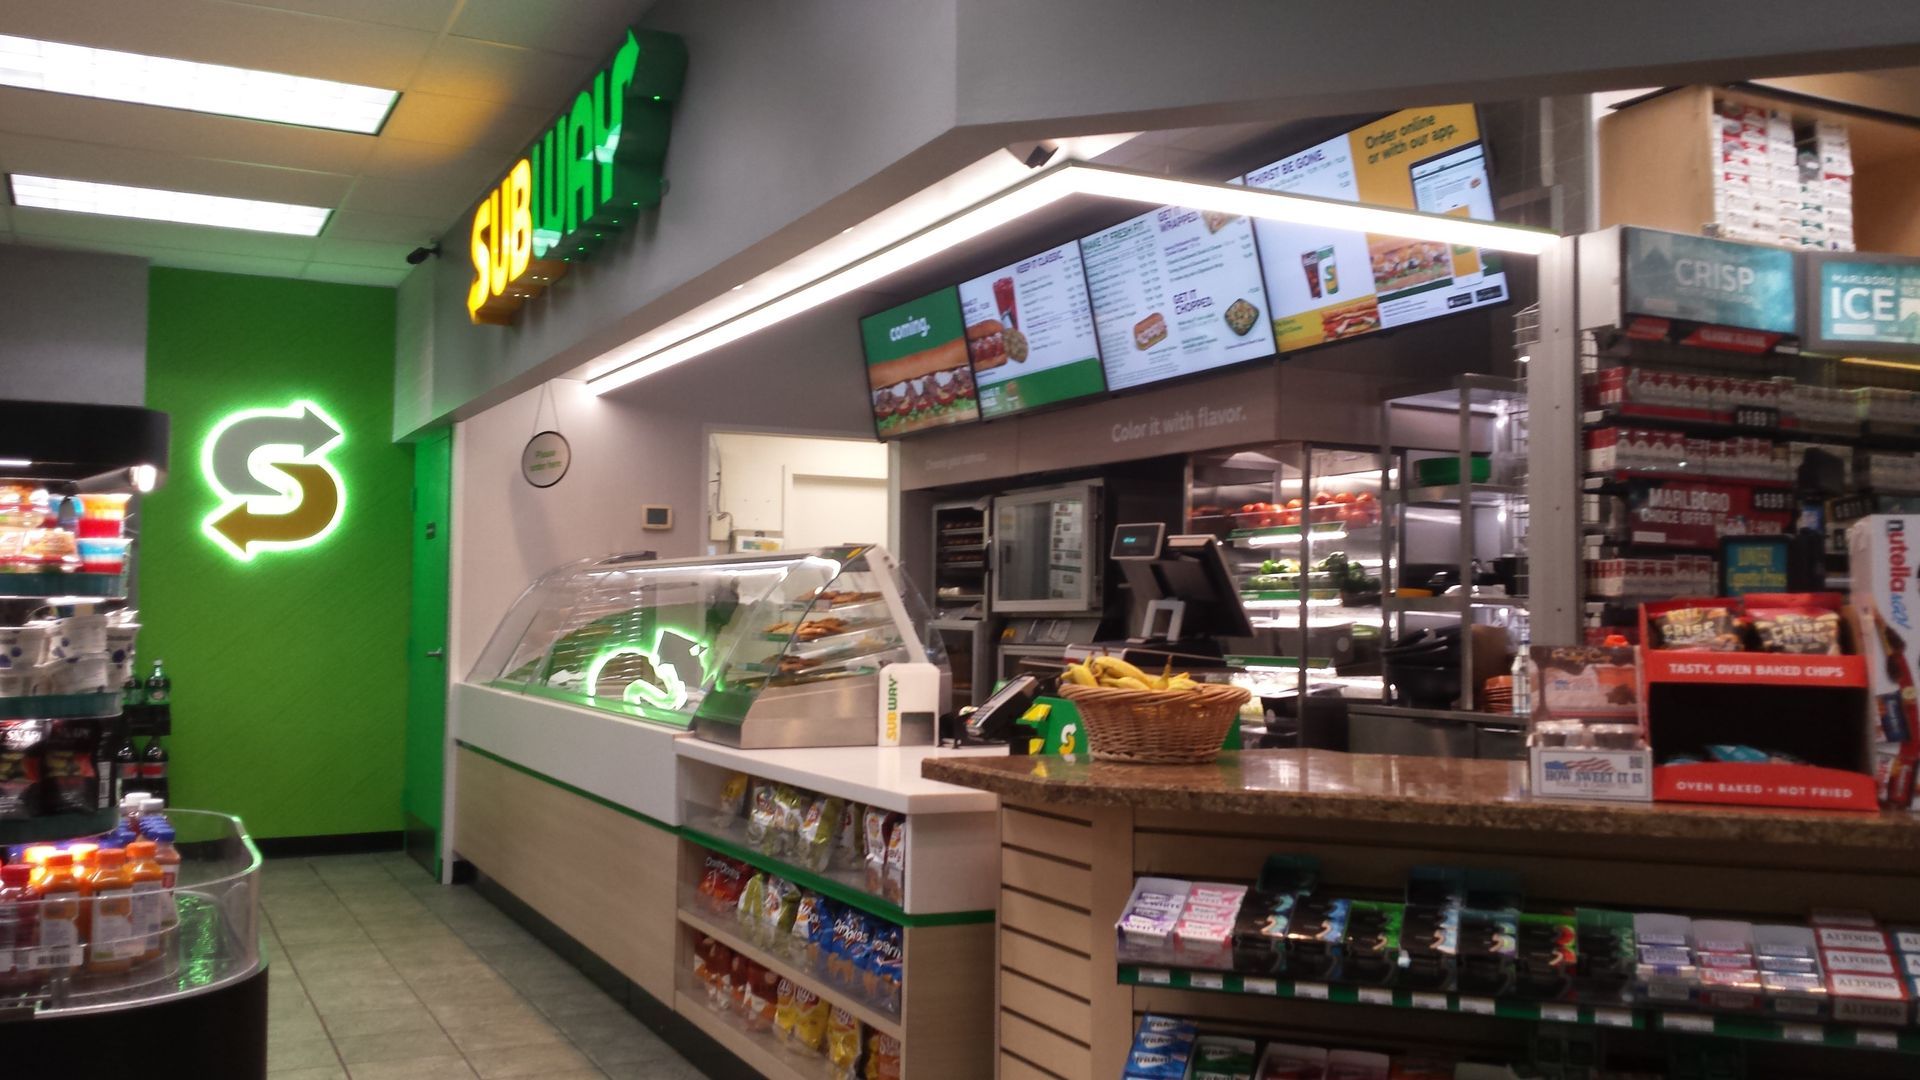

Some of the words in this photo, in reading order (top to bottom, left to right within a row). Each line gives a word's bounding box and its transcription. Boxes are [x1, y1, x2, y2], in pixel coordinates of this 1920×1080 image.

[1364, 128, 1397, 149] Order
[1400, 114, 1436, 137] online
[1367, 152, 1380, 164] or
[1382, 141, 1407, 160] with
[1410, 133, 1429, 149] our
[1432, 123, 1459, 143] app.
[467, 25, 640, 324] SUBWAY
[1247, 165, 1281, 185] THIRST
[1282, 159, 1296, 175] BE
[1157, 207, 1172, 222] GET
[1675, 258, 1756, 293] CRISP
[1831, 273, 1896, 286] MARLBORO
[1173, 292, 1188, 305] GET
[1831, 286, 1896, 321] ICE
[1111, 421, 1147, 443] Color
[1148, 416, 1161, 437] it
[1162, 410, 1194, 435] with
[1197, 405, 1247, 428] flavor.
[1647, 487, 1730, 512] MARLBORO
[1639, 507, 1679, 524] CHOICE
[1681, 510, 1713, 526] OFFER
[1888, 518, 1911, 593] nutella
[1771, 621, 1828, 641] CRISP
[1668, 663, 1714, 676] TASTY,
[1715, 663, 1752, 676] OVEN
[1755, 665, 1801, 677] BAKED
[1804, 666, 1845, 678] CHIPS
[886, 673, 899, 742] SUBWAY
[1545, 768, 1571, 780] HOW
[1575, 771, 1614, 783] SWEET
[1616, 772, 1628, 783] IT
[1631, 773, 1643, 783] IS
[1676, 781, 1713, 793] OVEN
[1718, 783, 1763, 795] BAKED
[1777, 785, 1807, 798] NOT
[1811, 786, 1853, 799] FRIED
